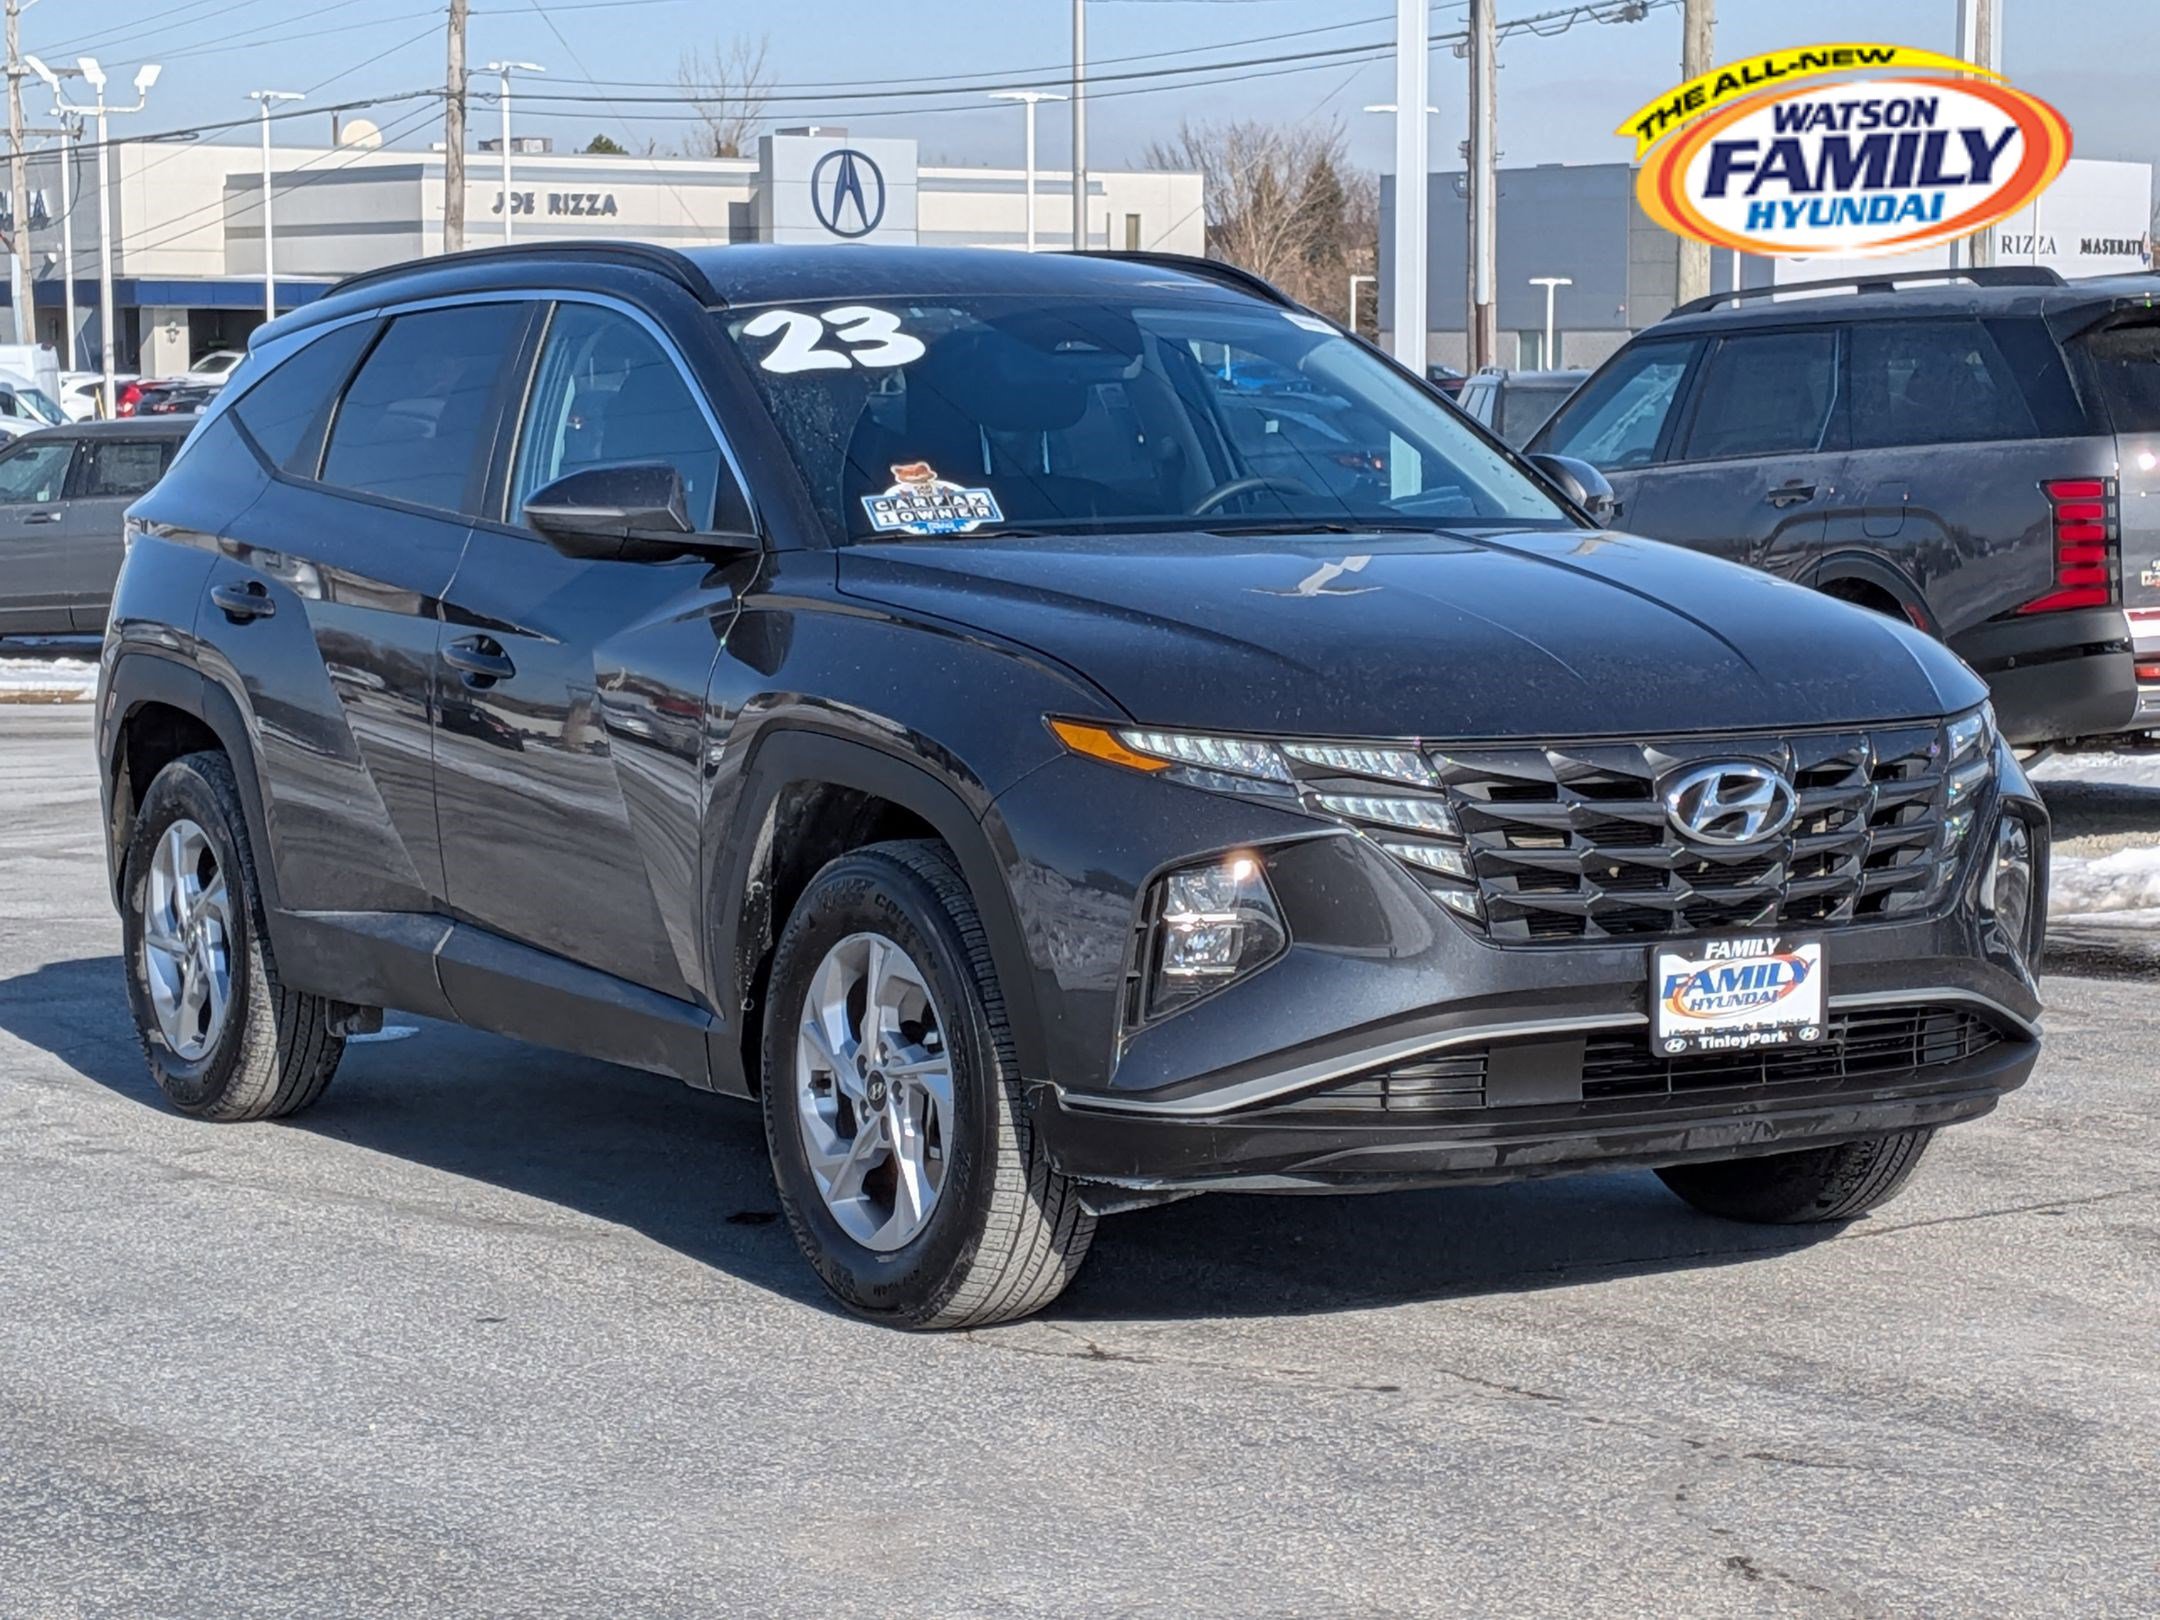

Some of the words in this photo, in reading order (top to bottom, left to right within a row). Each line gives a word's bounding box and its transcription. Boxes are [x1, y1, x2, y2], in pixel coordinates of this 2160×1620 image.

[491, 191, 536, 215] JOE
[547, 192, 618, 217] RIZZA
[2001, 234, 2057, 255] RIZZA
[742, 306, 926, 374] 23
[874, 495, 988, 512] CARFAX
[900, 505, 991, 523] OWNER
[1704, 937, 1781, 960] FAMILY
[1662, 958, 1817, 1000] FAMILY
[1689, 990, 1779, 1012] HYUNDAI
